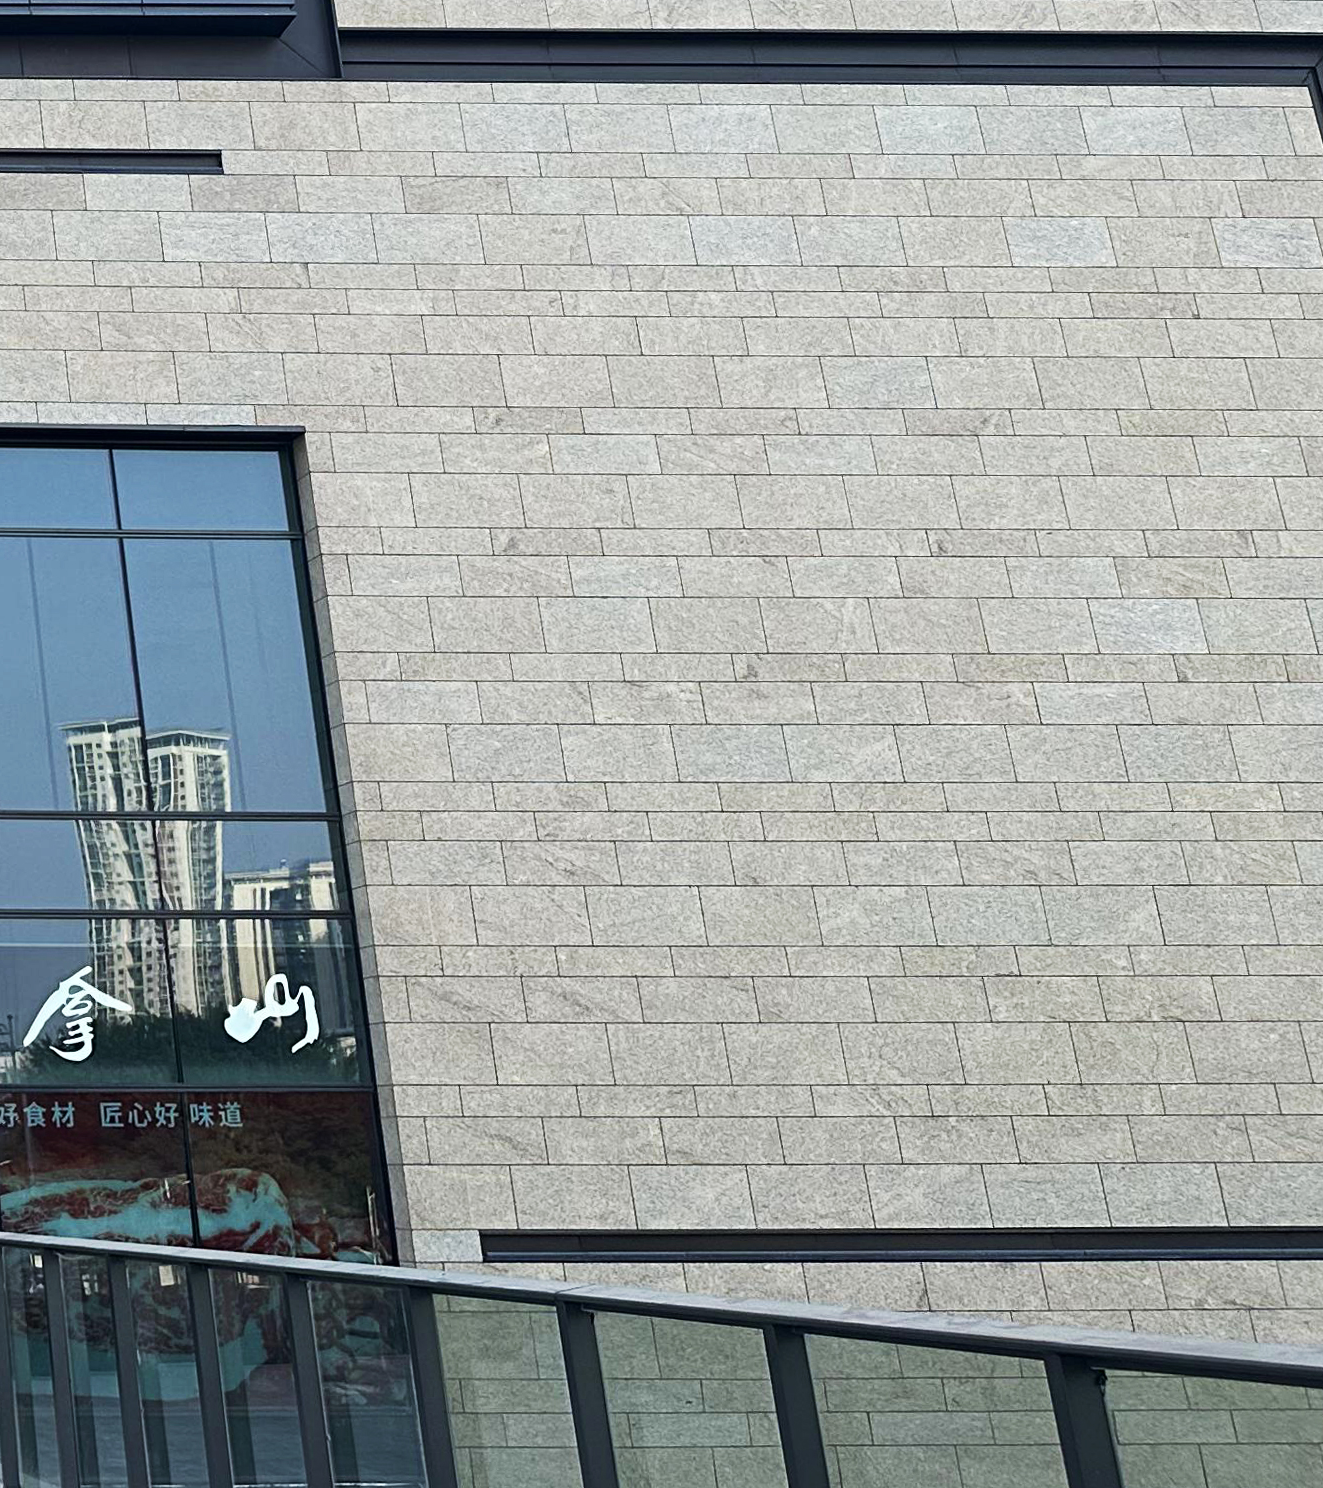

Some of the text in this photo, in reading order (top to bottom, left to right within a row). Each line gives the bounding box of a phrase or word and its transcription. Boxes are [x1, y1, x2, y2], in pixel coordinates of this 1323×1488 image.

[99, 1101, 244, 1129] 匠心好味道
